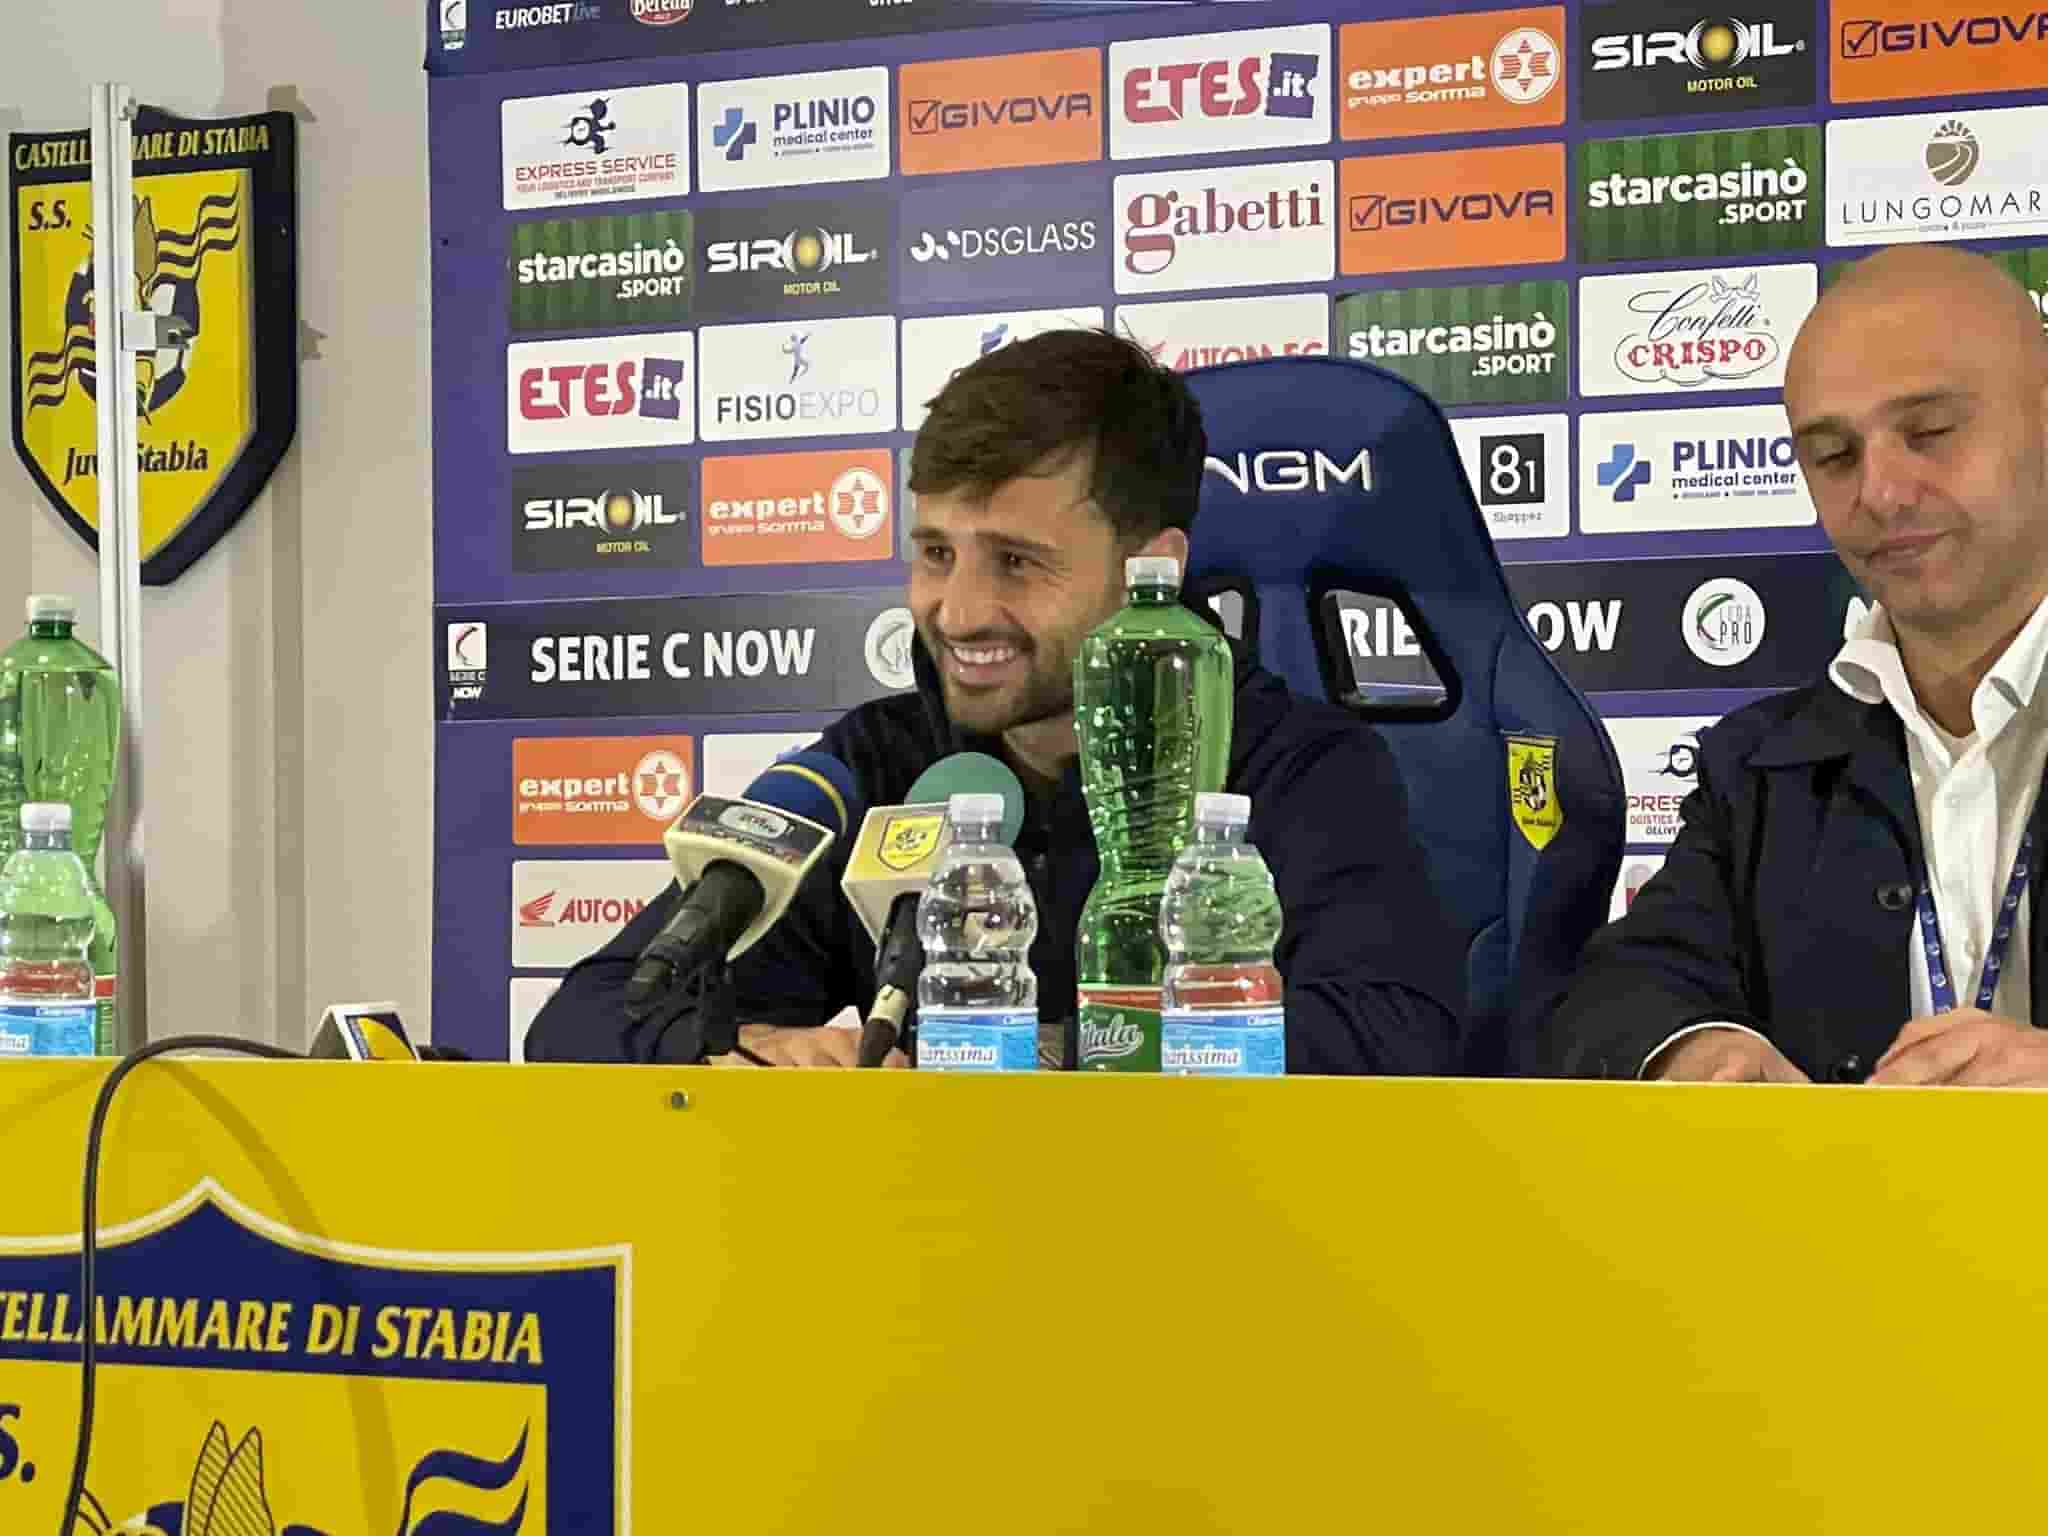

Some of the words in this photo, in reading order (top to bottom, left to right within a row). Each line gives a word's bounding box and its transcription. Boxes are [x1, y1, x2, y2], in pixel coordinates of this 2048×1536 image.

[1349, 55, 1486, 90] expert
[1688, 78, 1733, 92] MOTOR
[1737, 76, 1757, 88] OIL
[774, 95, 875, 131] PLINIO
[942, 93, 1091, 128] GIVOVA
[15, 131, 173, 170] CASTELLARE
[178, 127, 199, 157] DI
[202, 125, 270, 154] STABIA
[773, 129, 827, 147] medical
[830, 129, 873, 142] center
[515, 161, 597, 181] EXPRESS
[601, 153, 677, 174] SERVICE
[1588, 157, 1808, 208] starcasinò
[29, 199, 71, 230] S.S.
[1385, 190, 1553, 225] GIVOVA
[1718, 200, 1807, 224] .SPORT
[1843, 190, 2041, 224] LUNGOMAR
[961, 221, 1096, 258] DSGLASS
[1125, 183, 1324, 274] gabetti
[518, 239, 685, 283] starcasinò
[783, 282, 821, 296] MOTOR
[823, 281, 840, 293] OIL
[1348, 312, 1556, 358] starcasinò
[1472, 353, 1555, 376] .SPORT
[1627, 338, 1766, 369] CRISPO
[717, 388, 879, 423] FISIOEXPO
[1203, 449, 1372, 493] NGM
[1490, 445, 1536, 495] 81
[1673, 437, 1797, 472] PLINIO
[1672, 472, 1738, 488] medical
[1743, 472, 1796, 486] center
[709, 491, 825, 521] expert
[597, 542, 631, 553] MOTOR
[1340, 607, 1421, 657] RIE
[1527, 600, 1622, 652] OW
[1719, 622, 1752, 645] PRO
[531, 633, 651, 683] SERIE
[663, 632, 691, 679] C
[703, 628, 816, 677] NOW
[520, 772, 629, 798] expert
[1630, 815, 1674, 825] OGISTICS
[0, 1290, 292, 1353] ELLAMMARE
[304, 1304, 360, 1357] DI
[372, 1305, 544, 1366] STABIA
